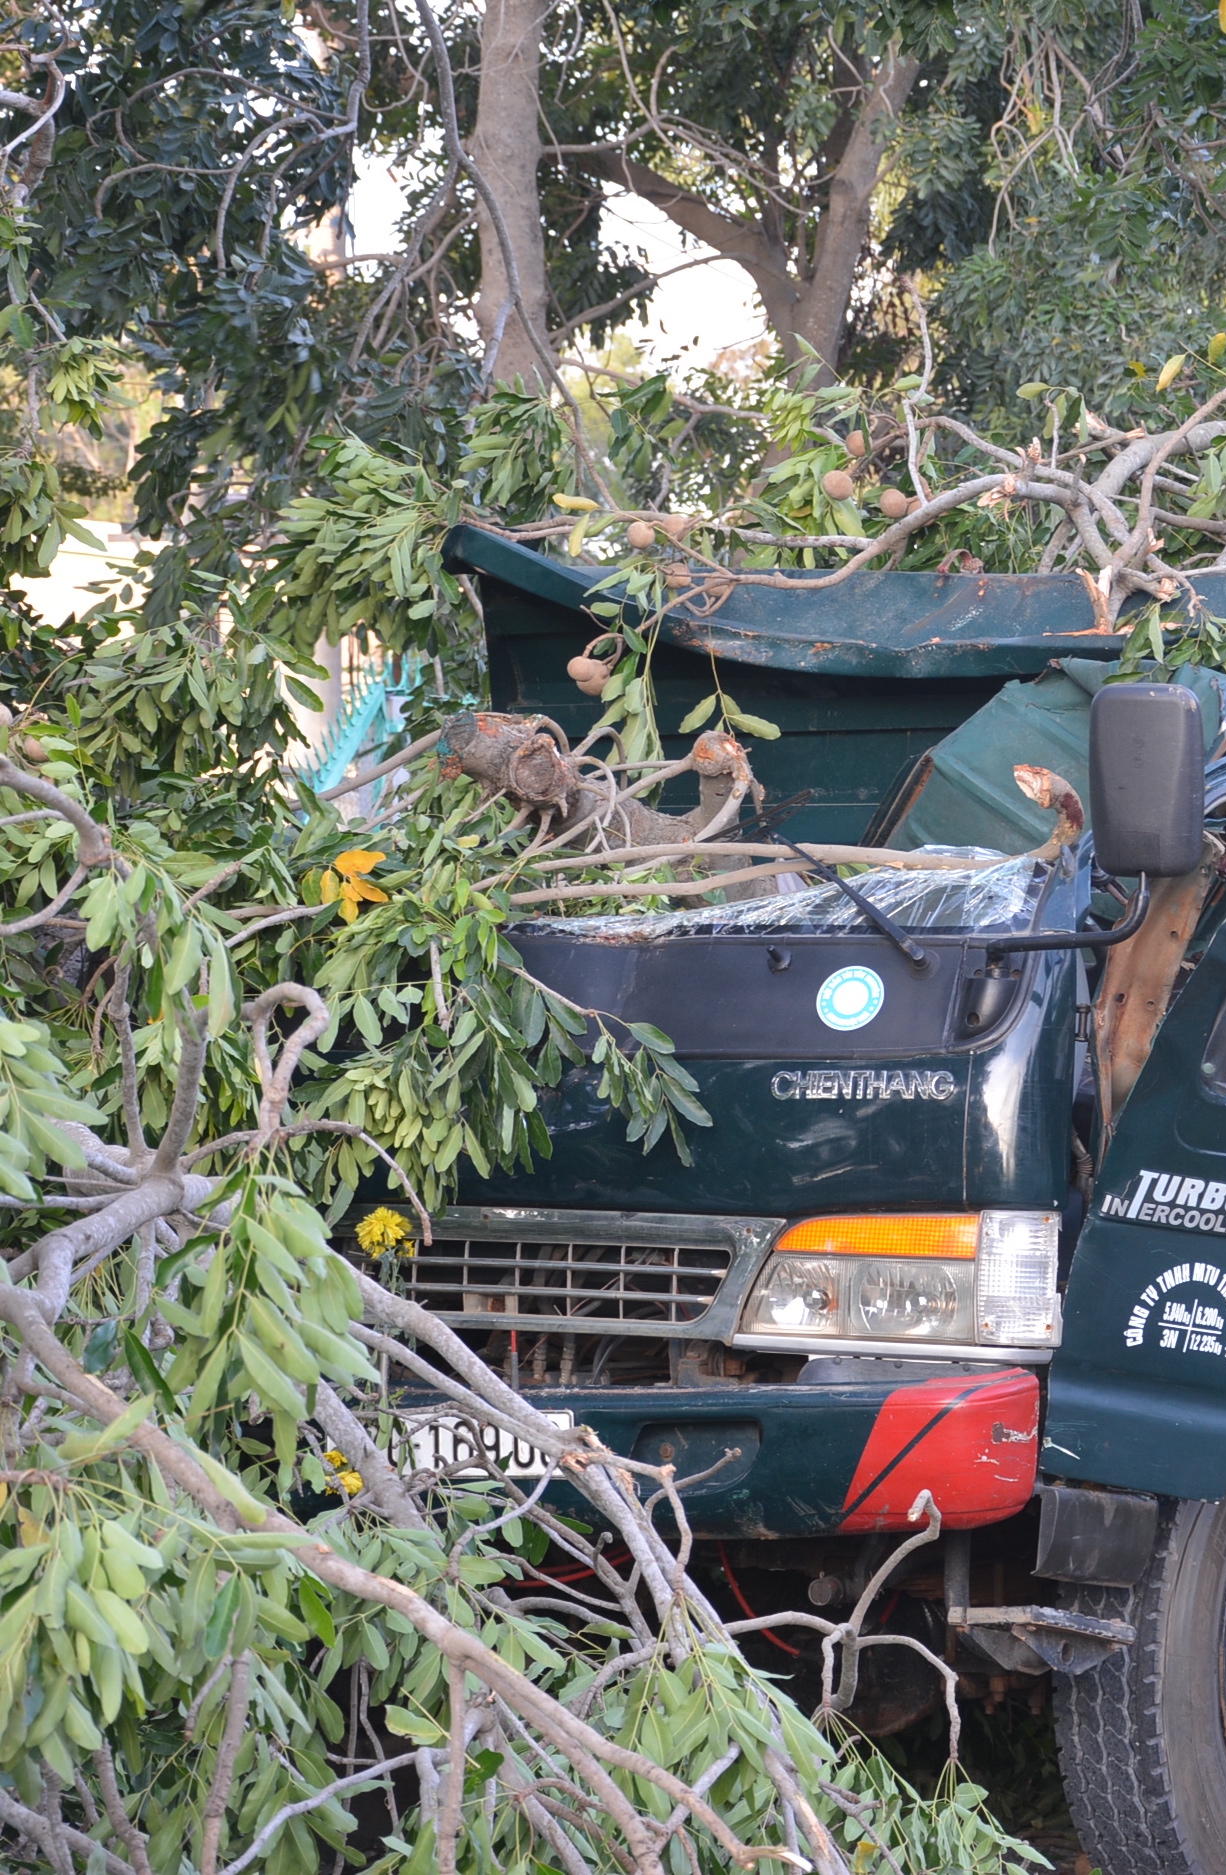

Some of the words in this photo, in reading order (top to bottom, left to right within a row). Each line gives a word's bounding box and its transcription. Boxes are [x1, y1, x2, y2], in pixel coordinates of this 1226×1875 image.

[770, 1070, 956, 1101] CHIENTHANG
[1123, 1305, 1151, 1347] CÔNG
[1155, 1263, 1191, 1294] TNHH
[1192, 1262, 1220, 1286] MTV
[1159, 1329, 1179, 1349] 3N
